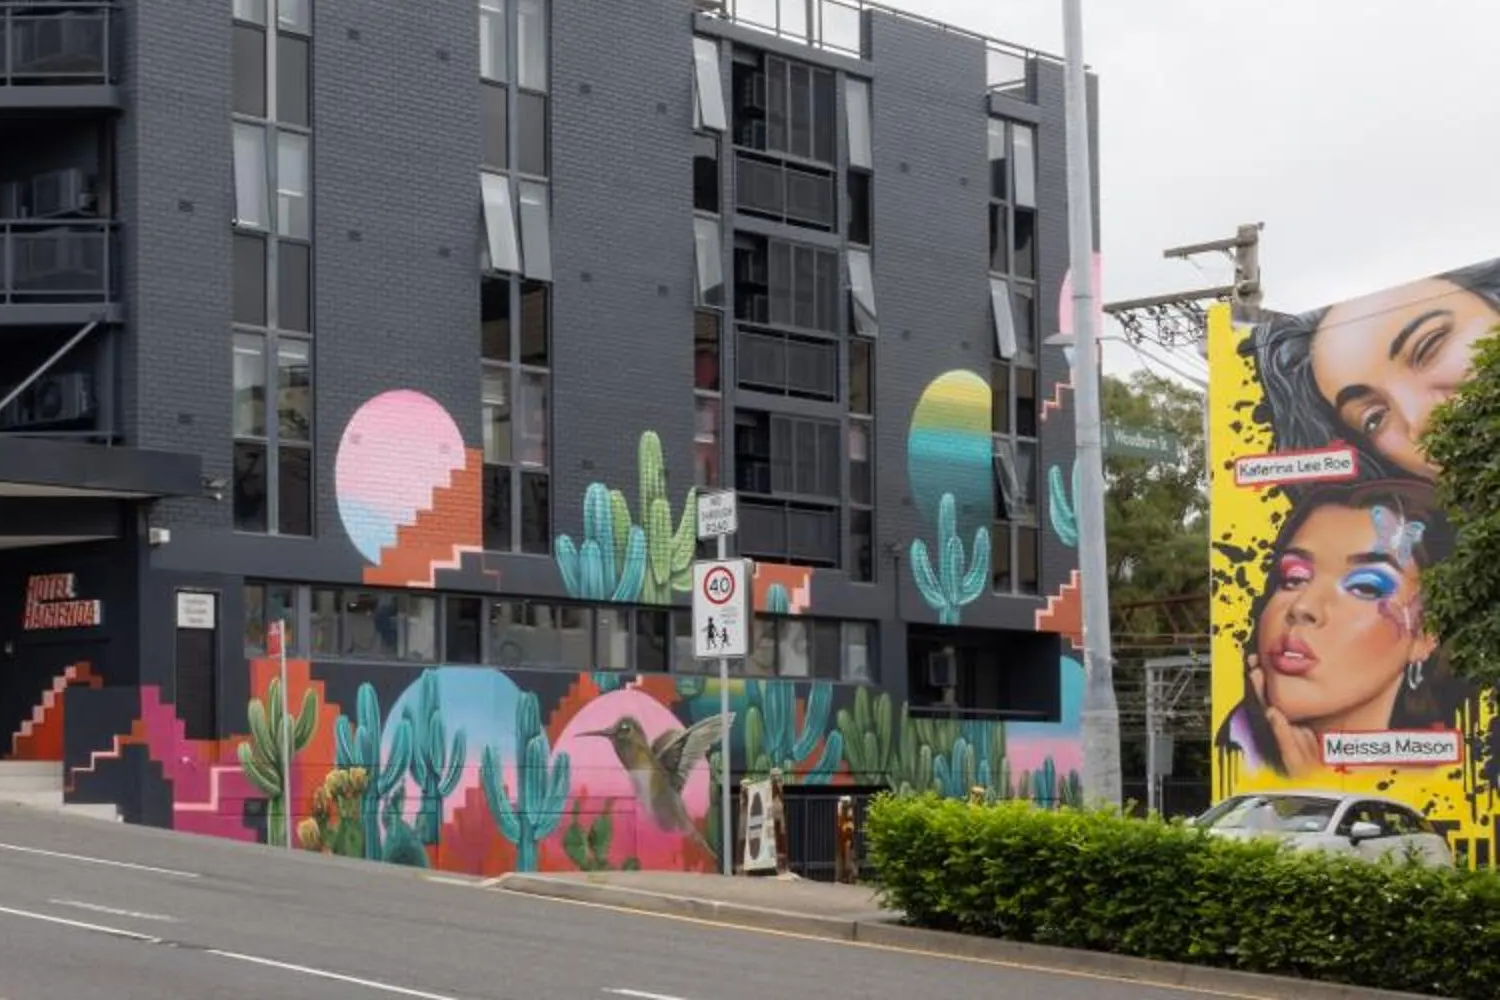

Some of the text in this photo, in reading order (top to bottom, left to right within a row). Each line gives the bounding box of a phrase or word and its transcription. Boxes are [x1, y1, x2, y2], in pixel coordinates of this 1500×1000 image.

[1297, 459, 1321, 473] Lee
[709, 576, 731, 594] 40
[1326, 738, 1454, 755] Meissa Mason
